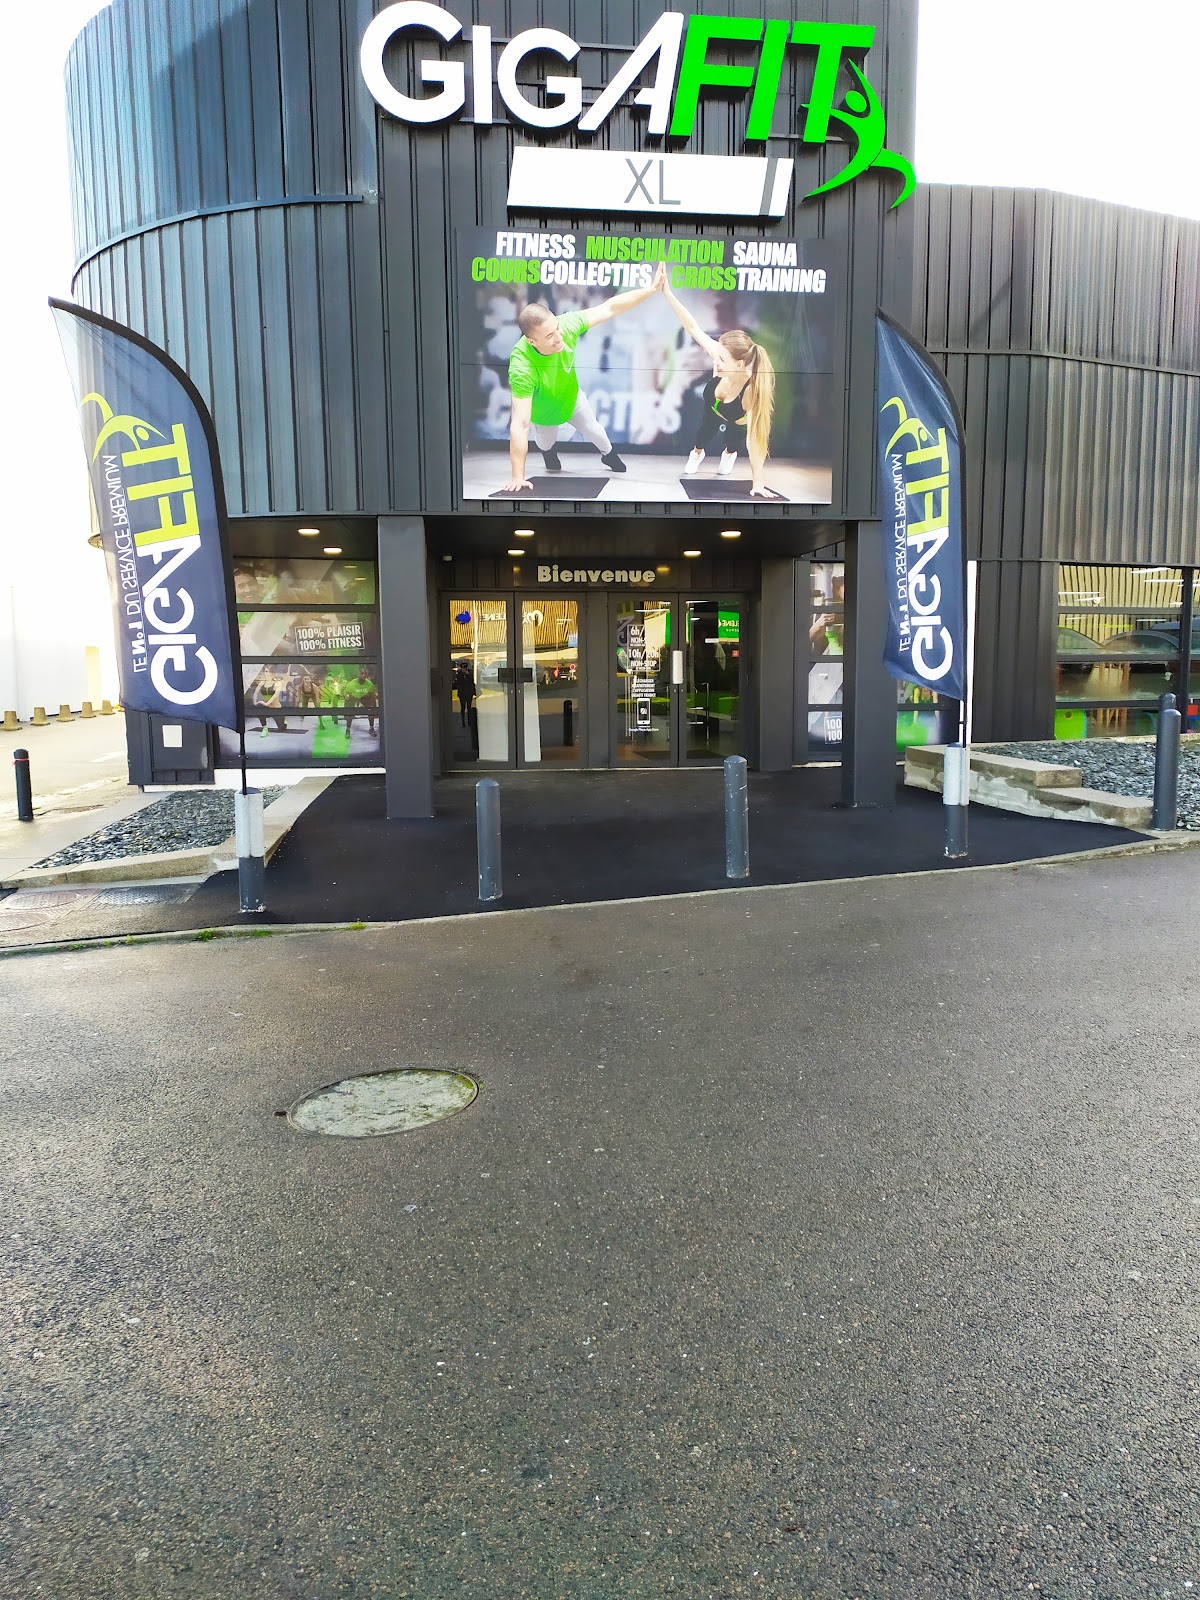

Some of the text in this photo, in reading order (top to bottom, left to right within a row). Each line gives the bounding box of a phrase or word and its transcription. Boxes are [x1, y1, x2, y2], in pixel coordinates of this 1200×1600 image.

[360, 0, 876, 144] GIGAFIT
[624, 158, 681, 205] XL
[496, 231, 798, 267] FITNESS MUSCULATION SAUNA
[537, 564, 656, 582] Bienvenue
[297, 624, 362, 640] 100% PLAISIR
[299, 636, 362, 651] 100% FITNESS
